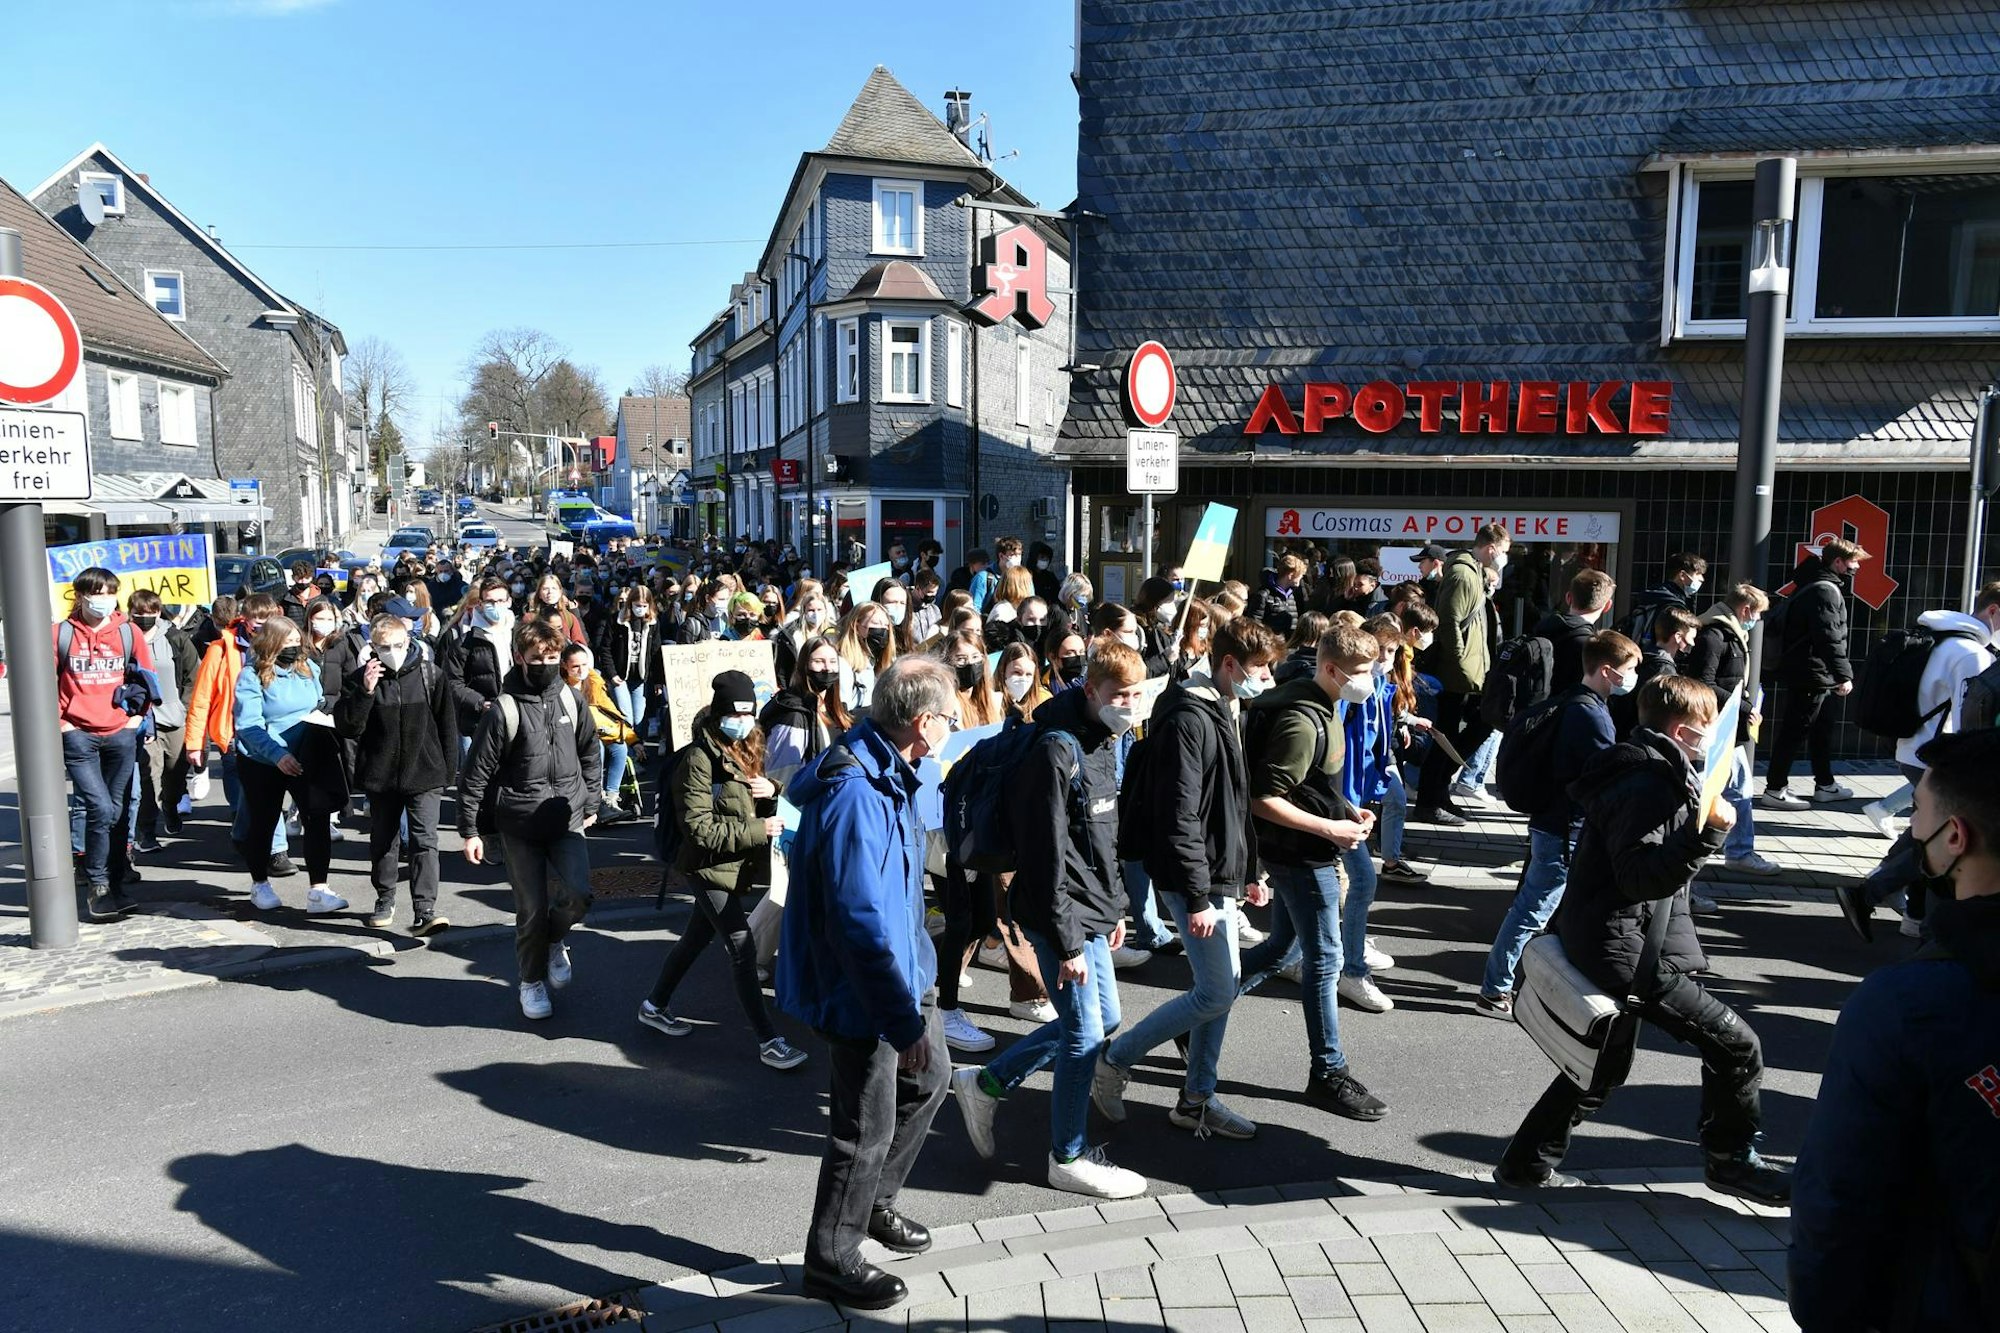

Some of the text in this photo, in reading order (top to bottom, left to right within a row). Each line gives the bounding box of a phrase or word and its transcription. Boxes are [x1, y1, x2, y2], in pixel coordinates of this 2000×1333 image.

[1243, 379, 1673, 434] APOTHEKE
[0, 419, 65, 439] inien-
[1137, 437, 1168, 450] Linien-
[0, 445, 71, 464] erkehr
[1135, 455, 1170, 468] verkehr
[14, 471, 50, 489] frei
[1145, 472, 1161, 484] frei
[1312, 511, 1392, 532] Cosmas
[56, 538, 194, 577] STOP PUTIN
